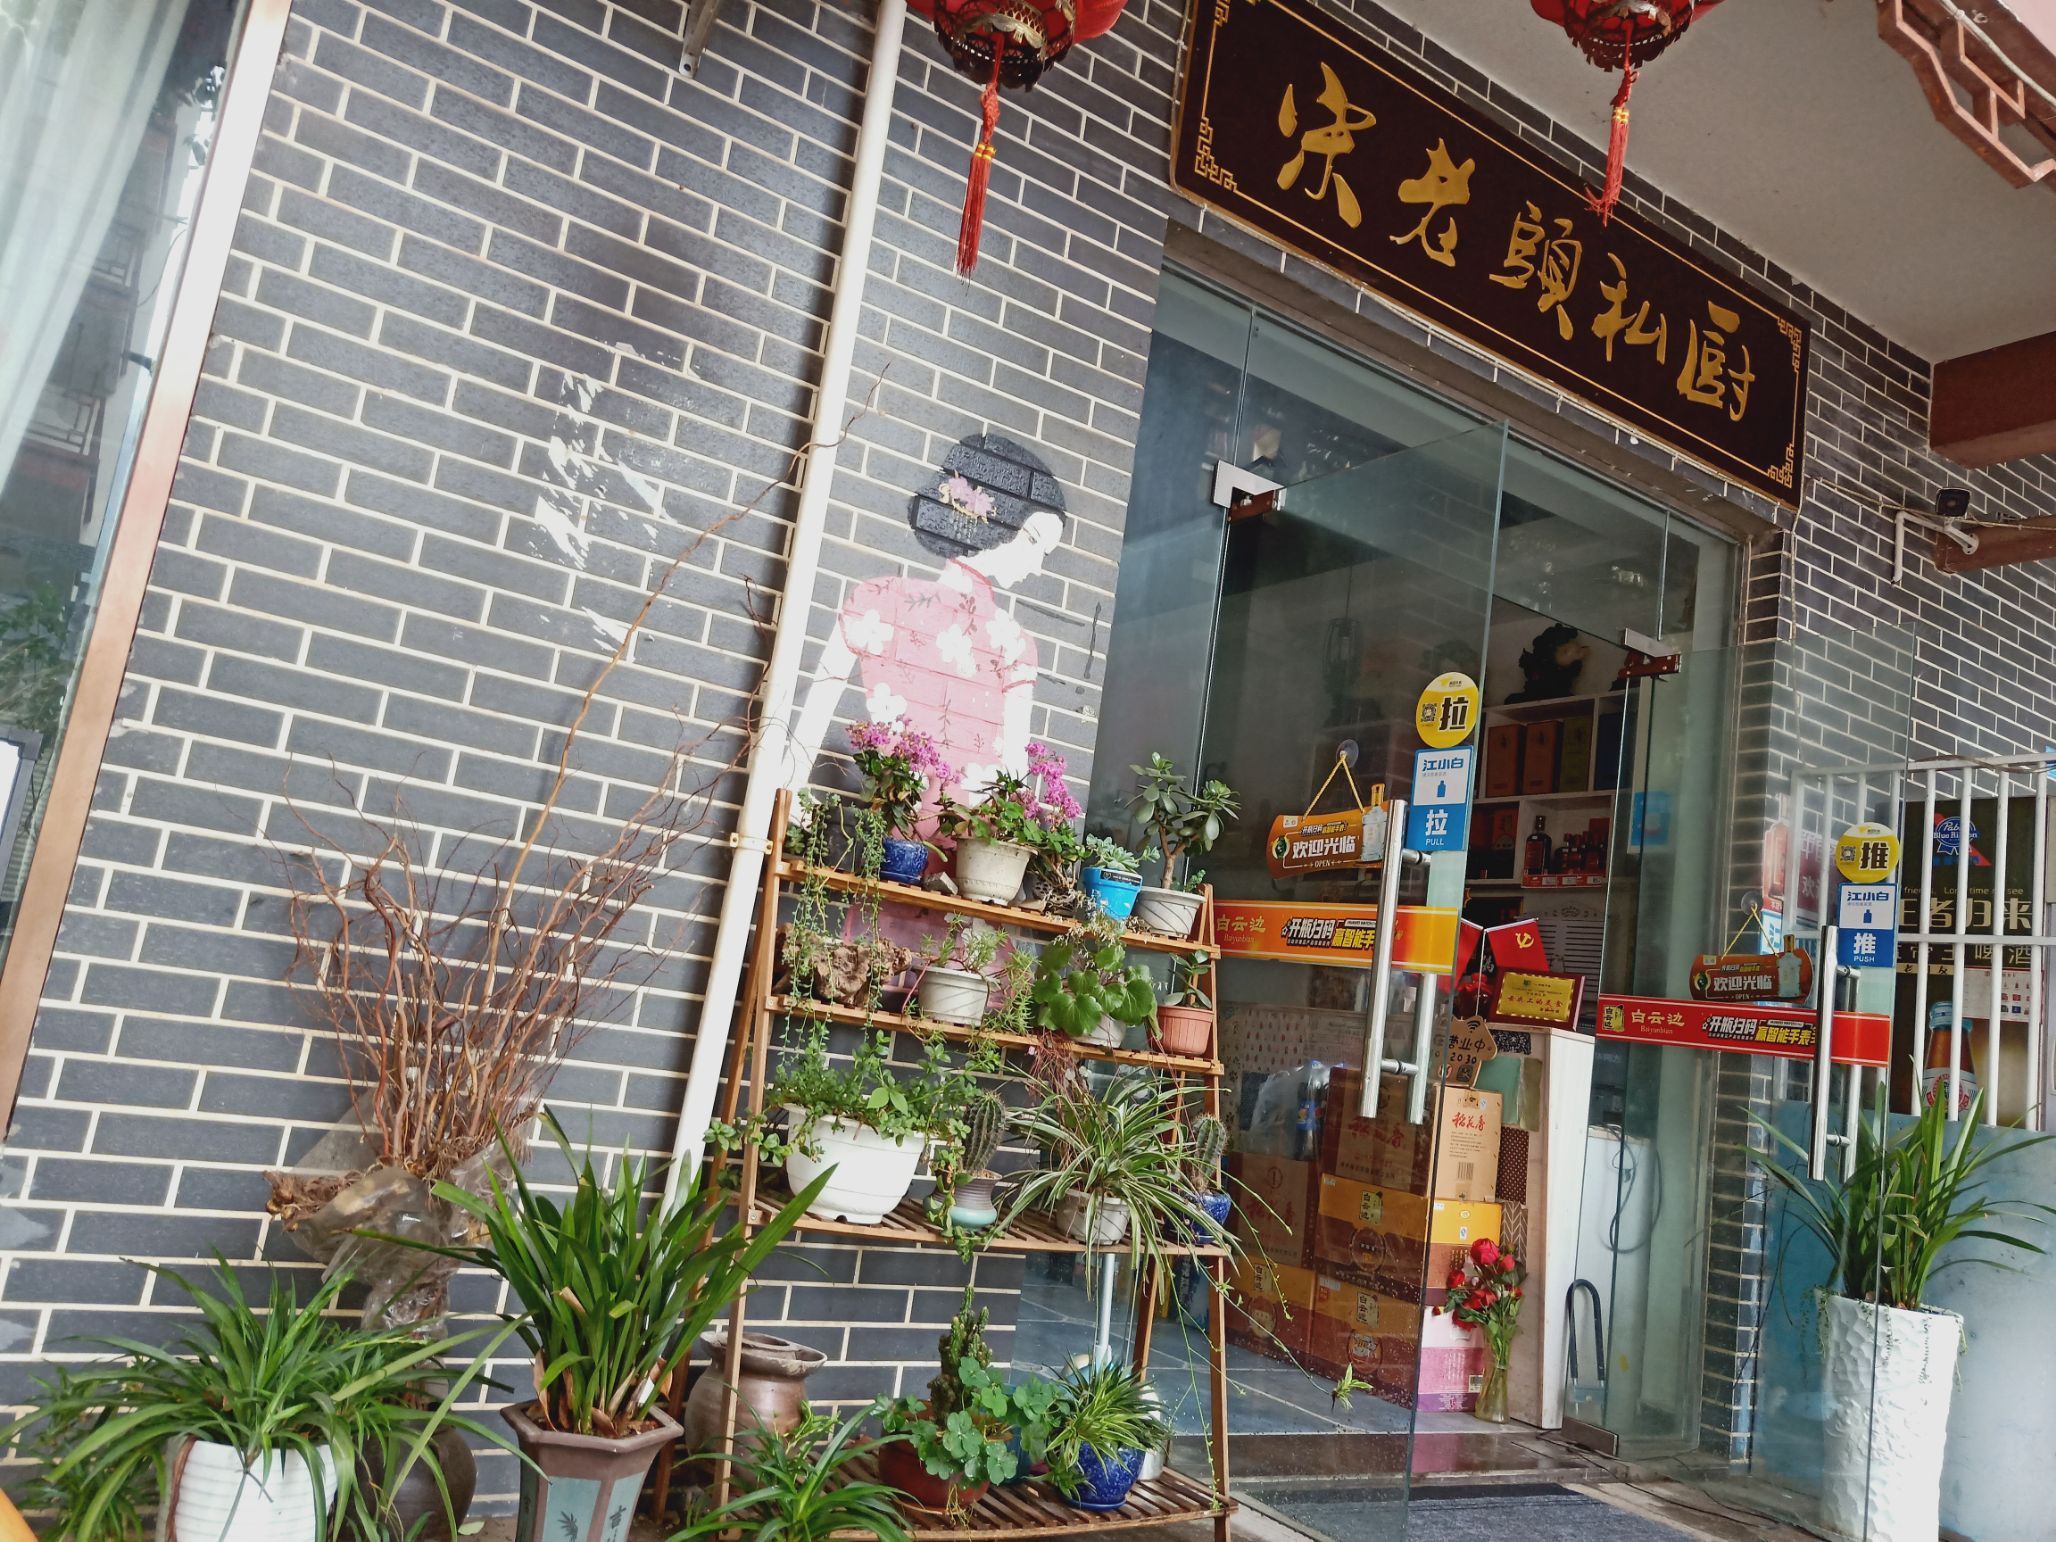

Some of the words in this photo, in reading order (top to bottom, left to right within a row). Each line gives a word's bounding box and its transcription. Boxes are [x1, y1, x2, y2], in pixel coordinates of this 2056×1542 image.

[1439, 696, 1469, 731] 拉
[1422, 757, 1464, 772] 江小白
[1425, 808, 1449, 836] 拉
[1292, 835, 1356, 860] 欢迎光临
[1425, 838, 1445, 846] PULL
[1314, 859, 1331, 868] OPEN
[1860, 842, 1889, 869] 推
[1847, 890, 1889, 902] 江小白
[2007, 887, 2024, 895] see
[1216, 913, 1267, 933] 白云边
[1289, 917, 1336, 940] 开瓶扫码
[1331, 927, 1376, 949] 赢智能手
[1853, 932, 1877, 955] 推
[1853, 955, 1875, 963] PUSH
[1713, 974, 1773, 992] 欢迎光临
[1631, 1008, 1685, 1027] 白云边
[1709, 1015, 1758, 1035] 开瓶扫码
[1754, 1026, 1812, 1046] 赢智能手表
[1452, 1111, 1486, 1132] 稻花香
